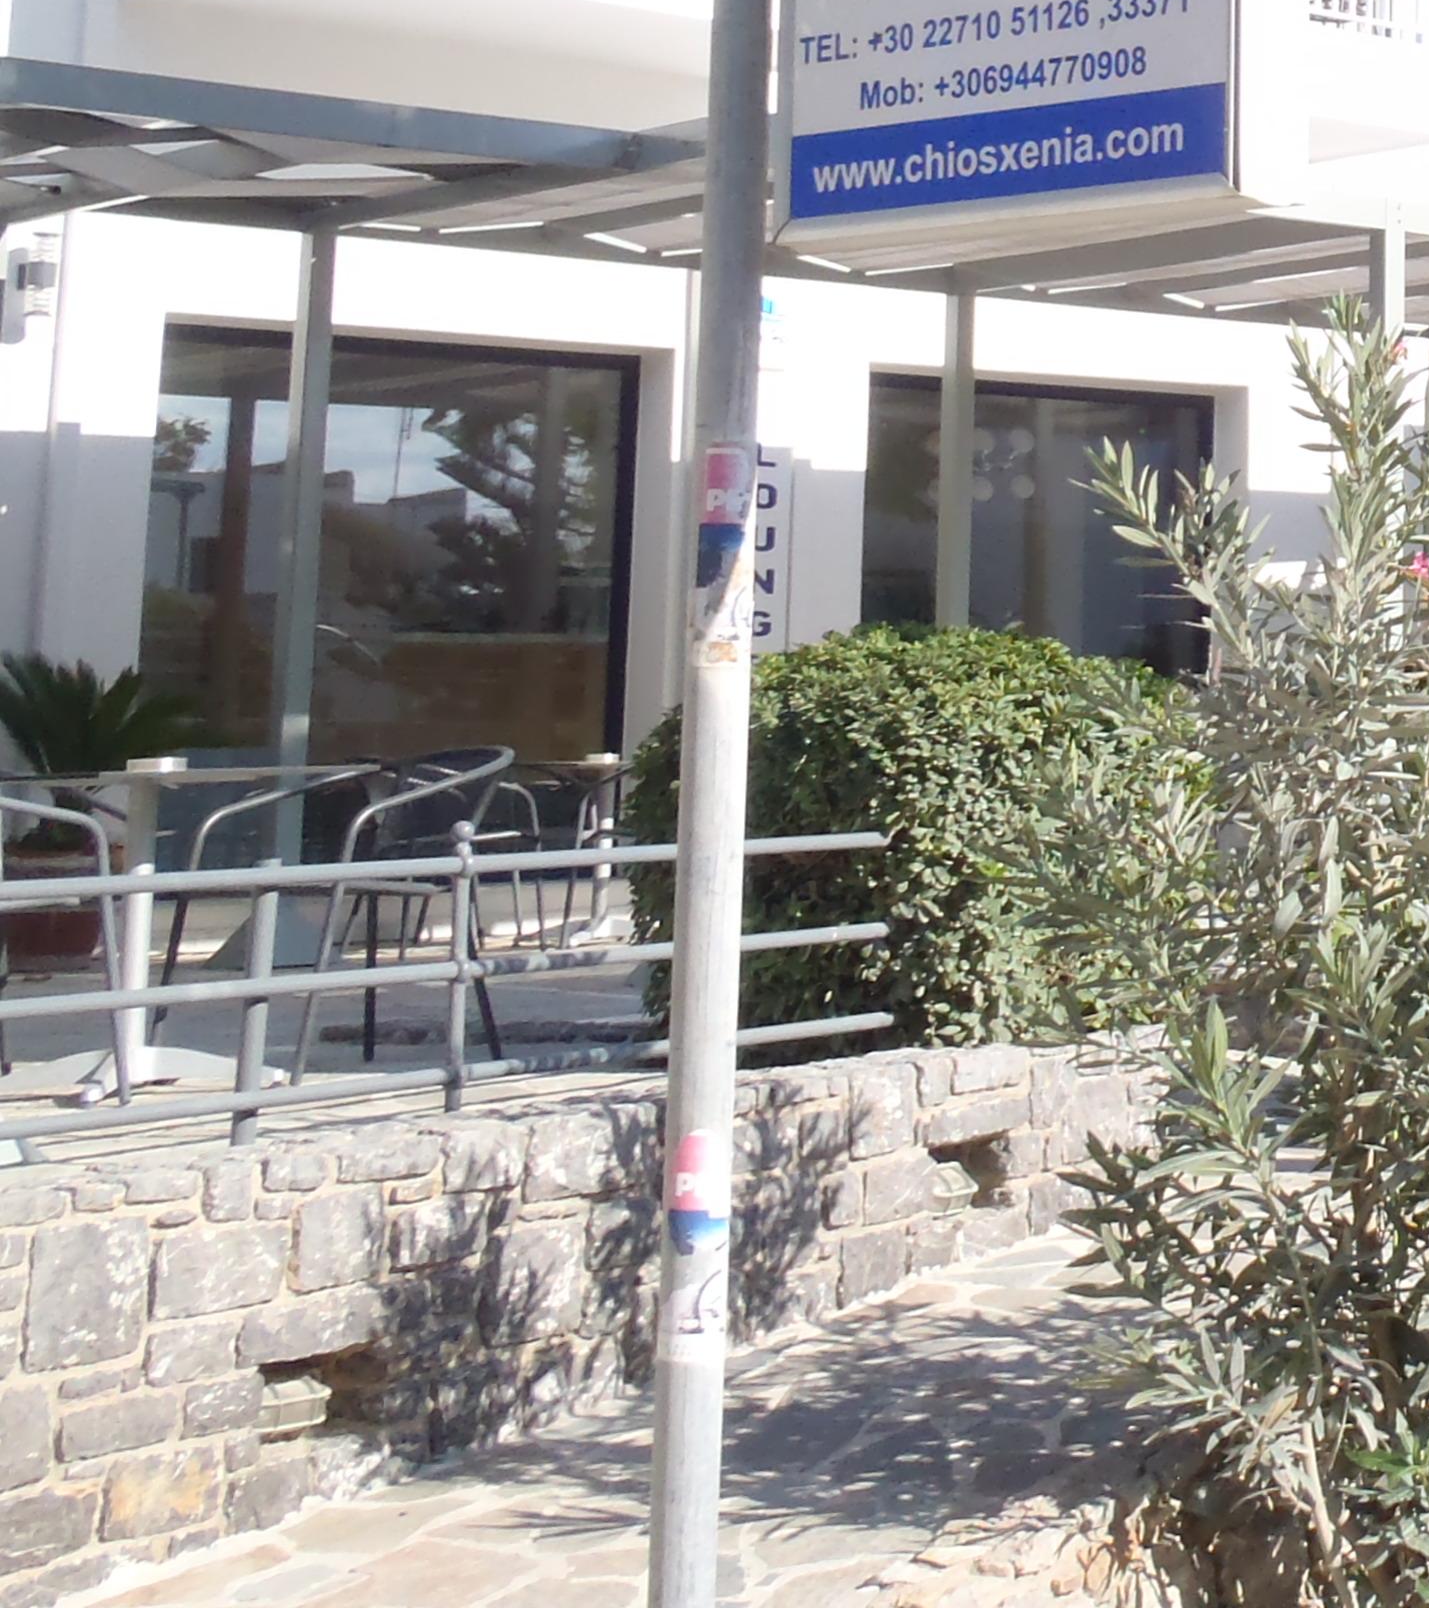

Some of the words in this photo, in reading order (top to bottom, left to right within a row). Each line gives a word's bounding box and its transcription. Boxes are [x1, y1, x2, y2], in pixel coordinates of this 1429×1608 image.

[799, 32, 858, 65] TEL:
[867, 22, 914, 54] +30
[922, 9, 1001, 49] 22710
[859, 77, 924, 110] Mob:
[934, 46, 1147, 98] +306944770908
[813, 121, 1184, 193] www.chiosxenia.com
